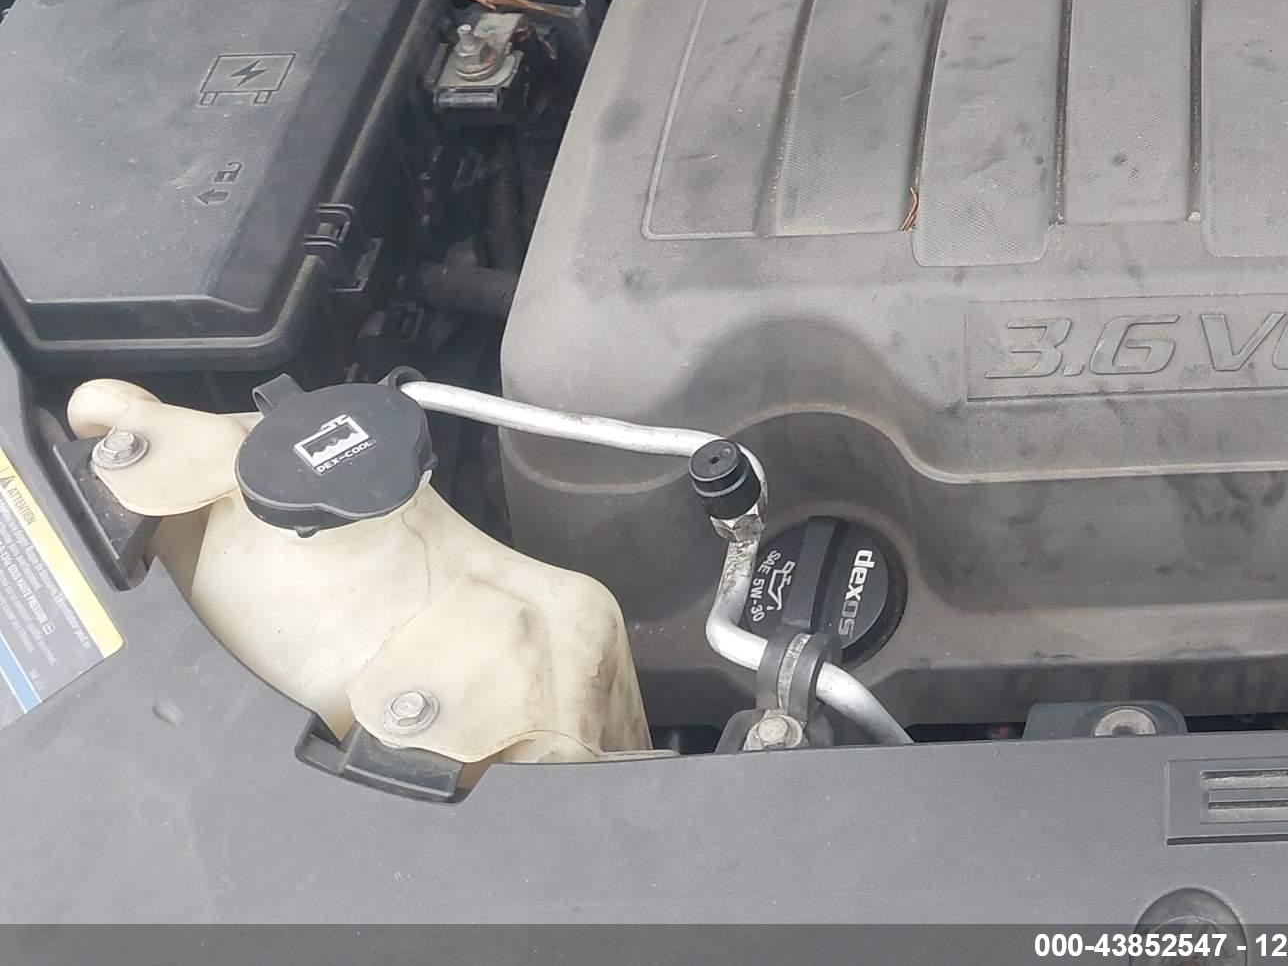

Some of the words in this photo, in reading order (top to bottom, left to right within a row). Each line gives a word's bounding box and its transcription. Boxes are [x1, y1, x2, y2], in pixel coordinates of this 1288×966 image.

[985, 314, 1180, 379] 3.6
[316, 440, 375, 474] DEX-COOL
[6, 485, 37, 526] ATTENTION
[756, 550, 782, 575] SAE
[750, 578, 765, 622] 5W-30
[838, 549, 876, 640] dexos
